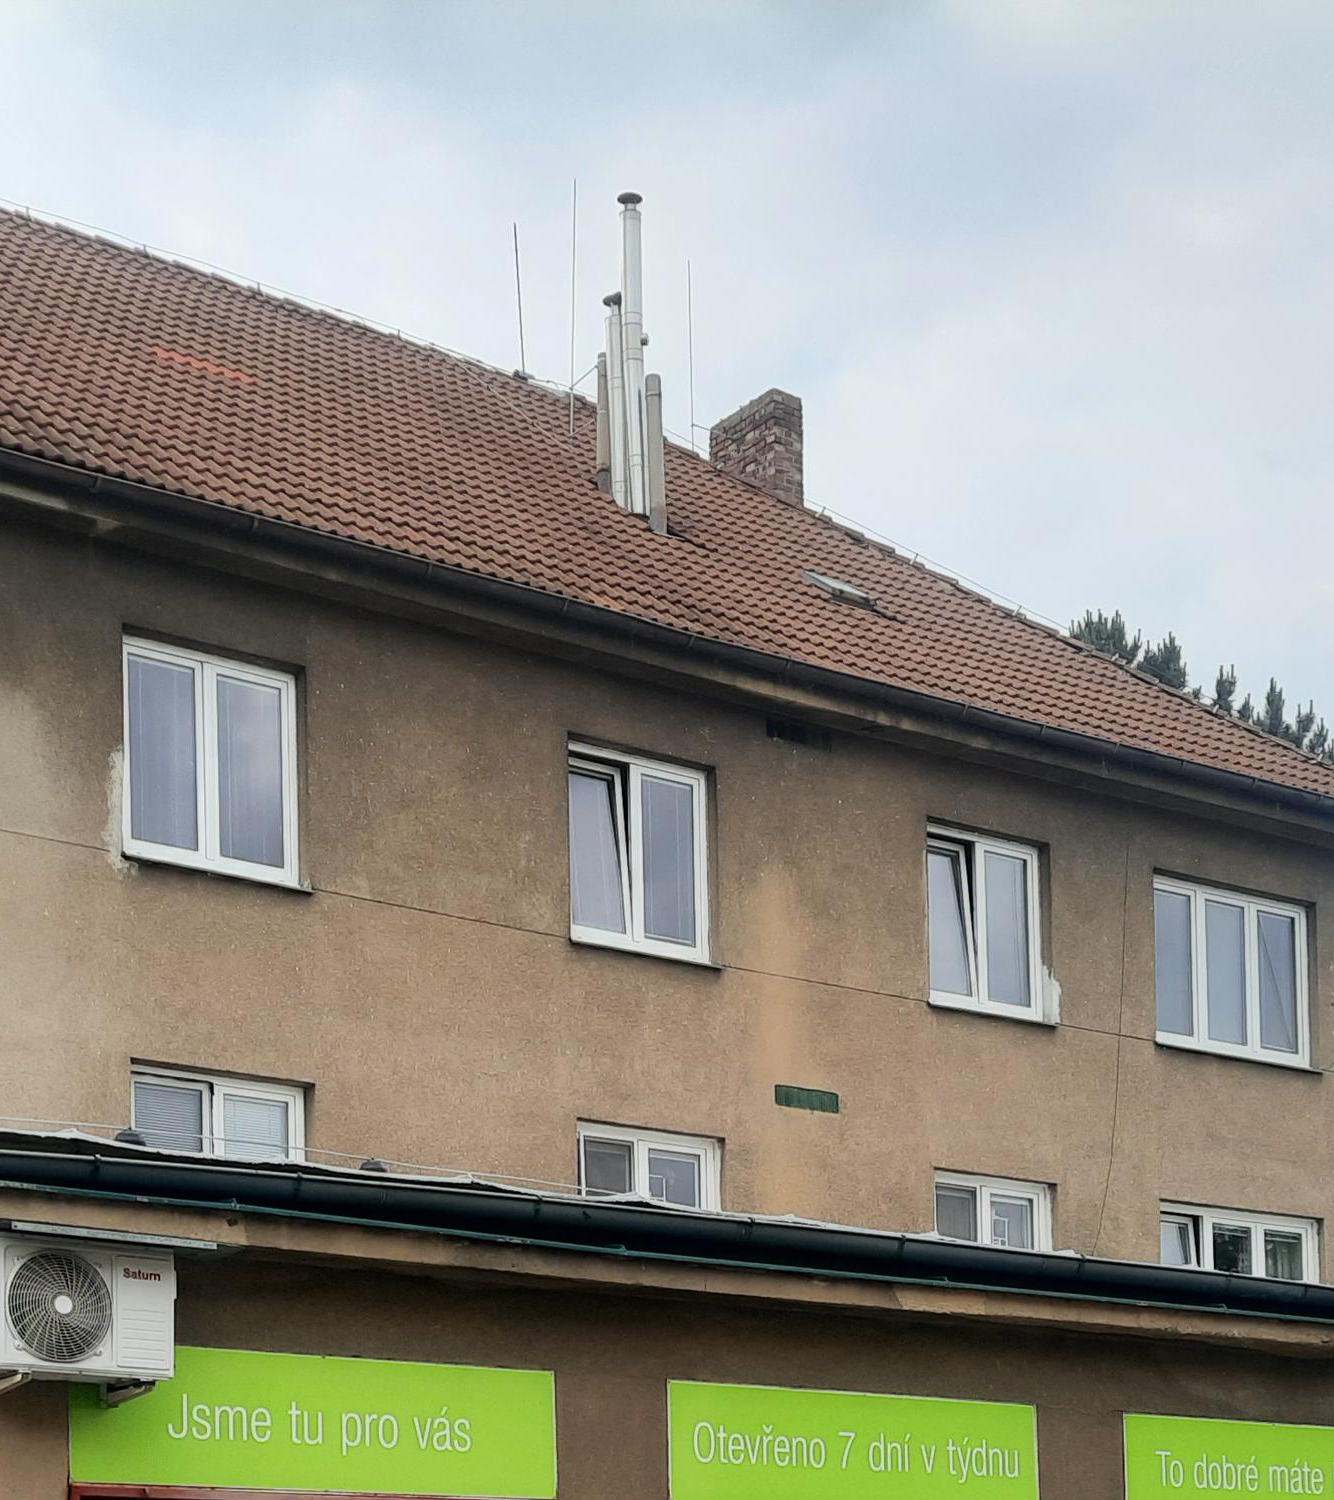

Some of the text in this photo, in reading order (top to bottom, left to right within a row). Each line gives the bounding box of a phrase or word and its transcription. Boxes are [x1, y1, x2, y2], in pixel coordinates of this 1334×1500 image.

[122, 1267, 161, 1283] Saturn
[167, 1393, 471, 1456] Jsme tu pro vás
[692, 1421, 1020, 1483] Otevřeno 7 dní v týdnu
[1155, 1450, 1184, 1488] To
[1194, 1454, 1259, 1491] dobré
[1269, 1458, 1324, 1494] máte
